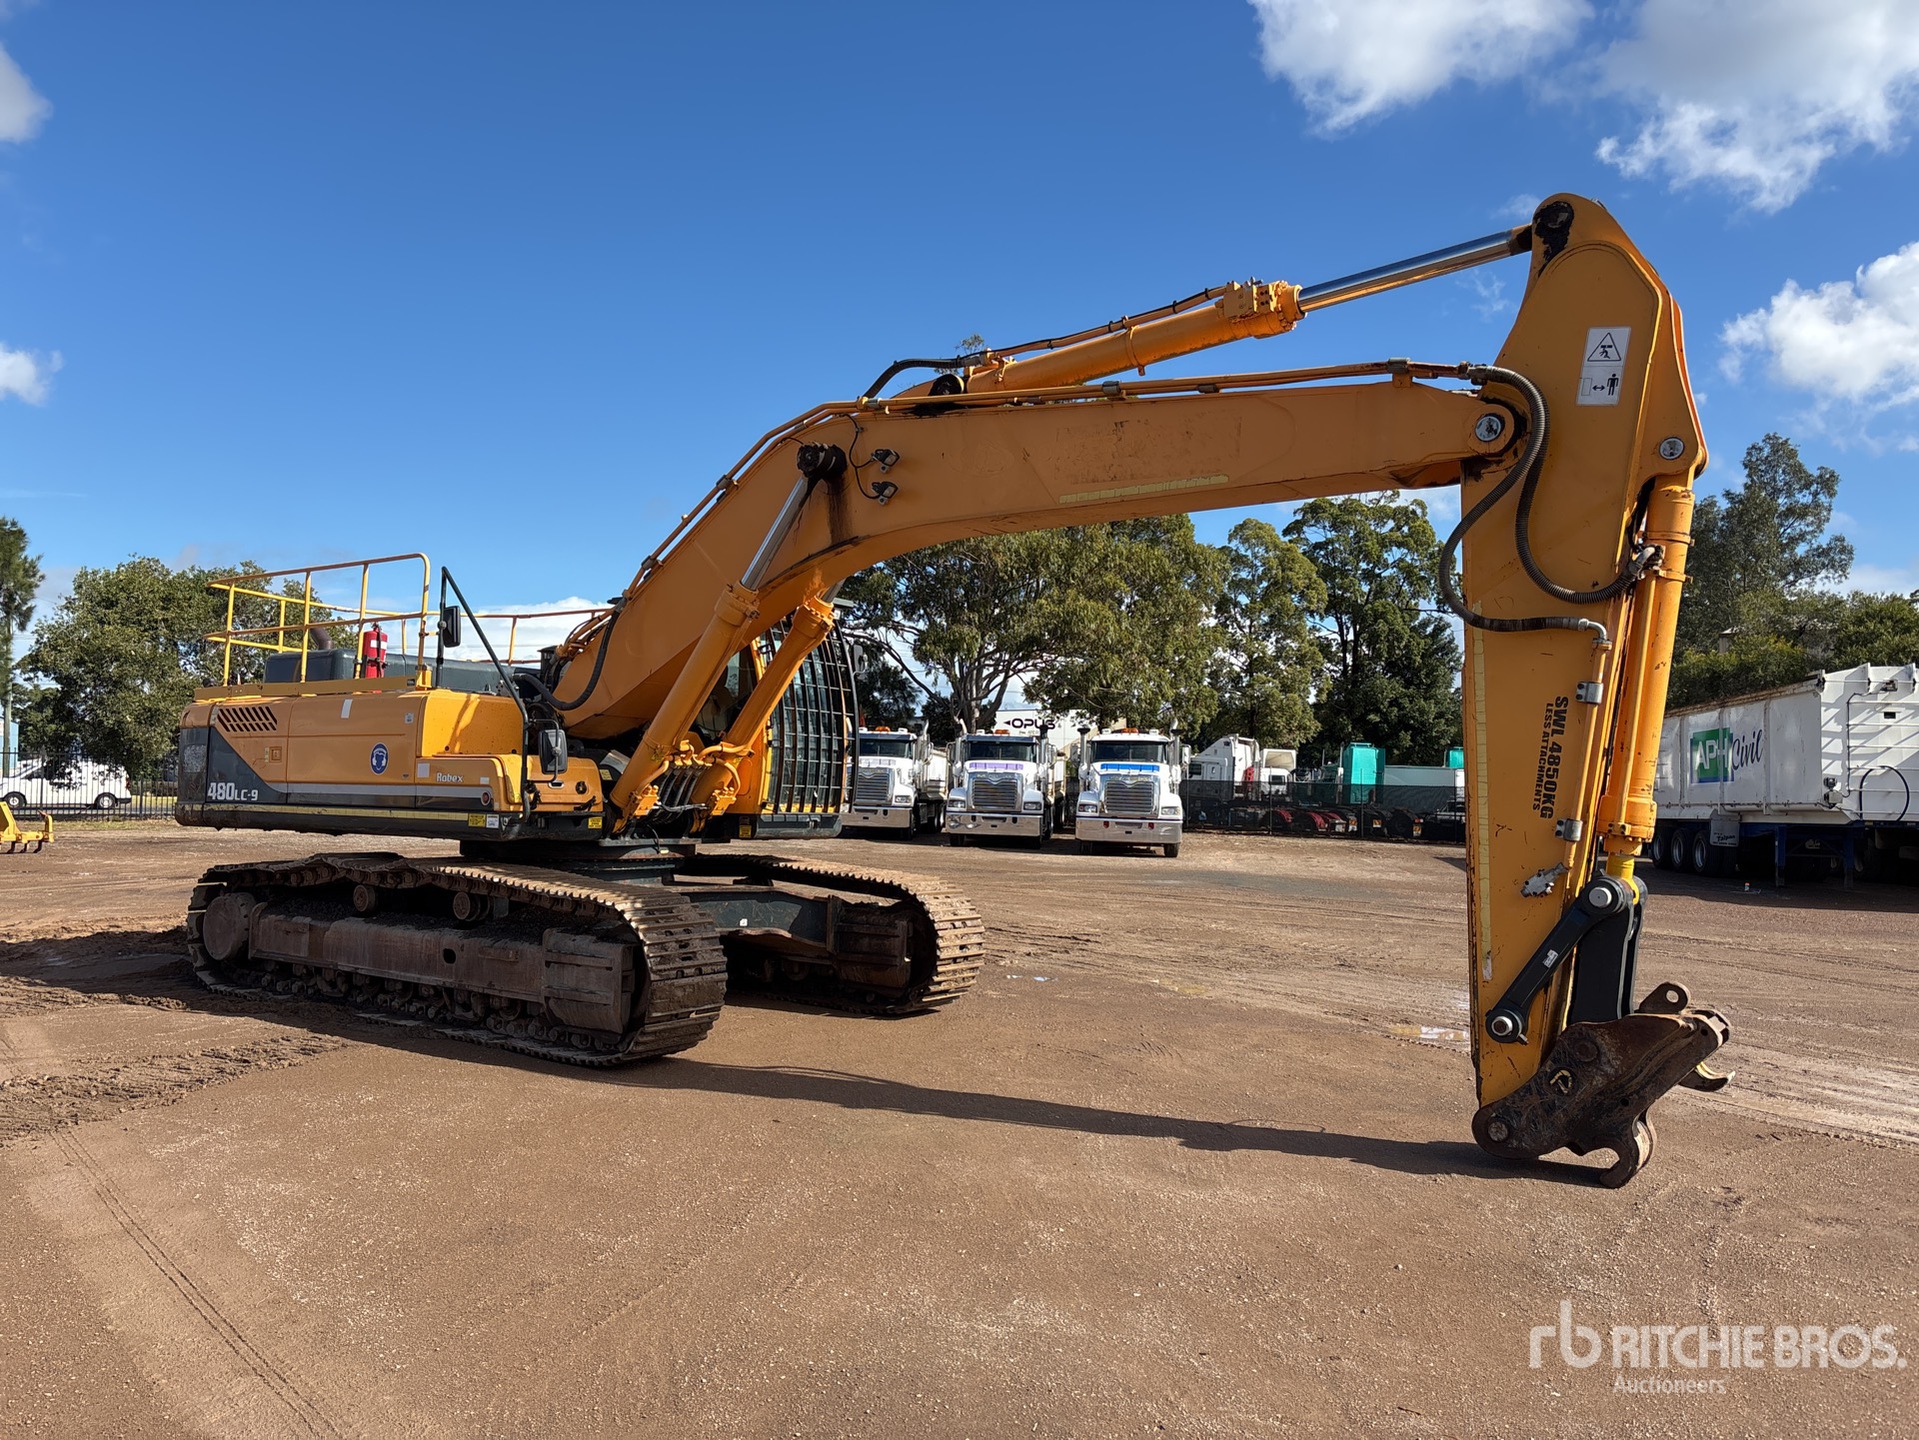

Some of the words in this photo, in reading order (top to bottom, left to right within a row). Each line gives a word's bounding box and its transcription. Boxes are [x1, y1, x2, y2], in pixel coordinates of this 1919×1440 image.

[1012, 718, 1056, 729] OPUS
[1543, 703, 1554, 729] LESS
[1551, 696, 1569, 737] SWL
[1732, 729, 1763, 771] Civil
[436, 772, 464, 782] Robex
[1532, 731, 1550, 811] ATTACHMENTS
[1540, 741, 1563, 819] 4850KG
